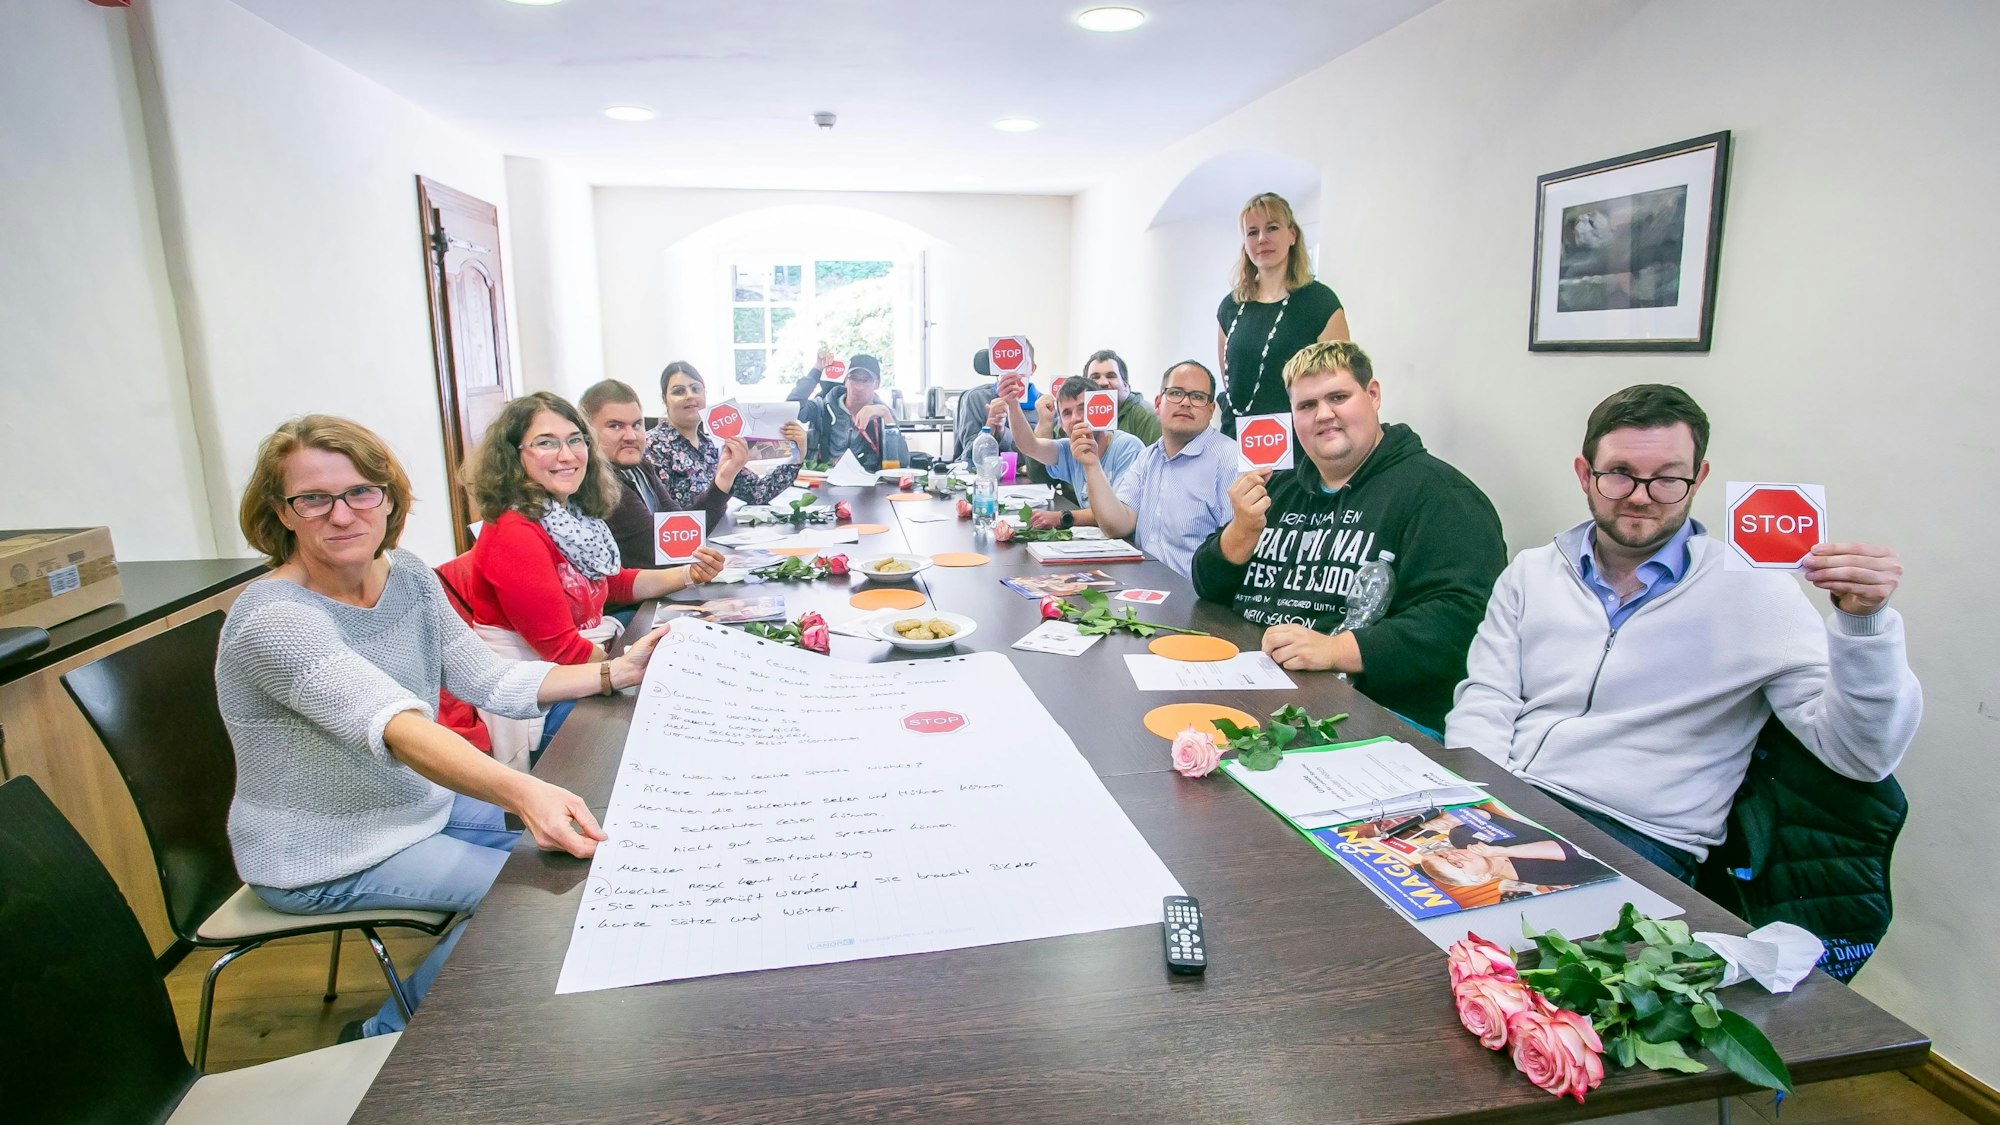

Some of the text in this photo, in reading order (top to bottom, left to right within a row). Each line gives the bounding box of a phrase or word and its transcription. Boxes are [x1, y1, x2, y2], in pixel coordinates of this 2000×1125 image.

[995, 349, 1021, 358] STOP
[1088, 405, 1113, 415] STOP
[711, 412, 739, 430] STOP
[1244, 432, 1285, 449] STOP
[1740, 514, 1814, 534] STOP
[662, 530, 700, 543] STOP
[1313, 601, 1336, 613] WITH
[909, 716, 960, 726] STOP
[629, 820, 661, 830] Die
[619, 839, 650, 850] Die
[728, 839, 752, 850] gut
